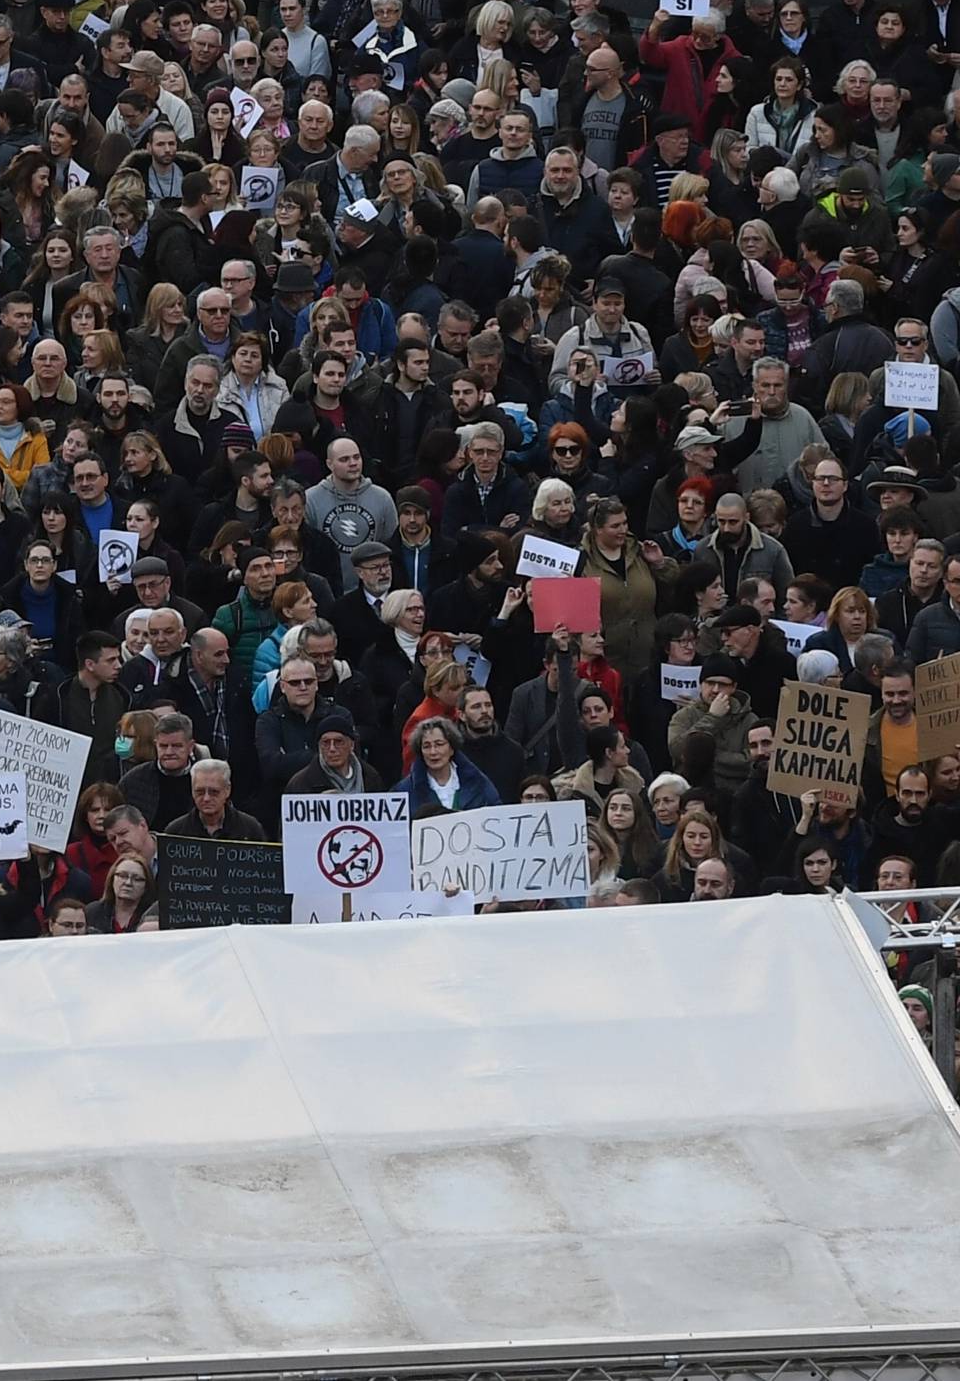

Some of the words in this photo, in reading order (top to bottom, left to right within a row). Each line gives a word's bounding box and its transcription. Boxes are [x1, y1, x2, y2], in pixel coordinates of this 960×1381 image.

[82, 24, 99, 38] DOS
[523, 550, 557, 569] DOSTA
[663, 676, 698, 689] DOSTA
[797, 689, 849, 721] DOLE
[25, 725, 71, 753] ŽIČAROM
[783, 718, 851, 756] SLUGA
[4, 739, 48, 765] PREKO
[774, 748, 858, 785] KAPITALA
[27, 783, 68, 808] OTOROM
[824, 789, 851, 804] ISKRA
[285, 800, 331, 822] JOHN
[337, 797, 407, 822] OBRAZ
[418, 810, 555, 866] DOSTA
[166, 843, 202, 860] GRUPA
[216, 845, 281, 863] PODRŠKE
[171, 865, 218, 878] DOKTORU
[418, 852, 588, 896] BANDITIZMA
